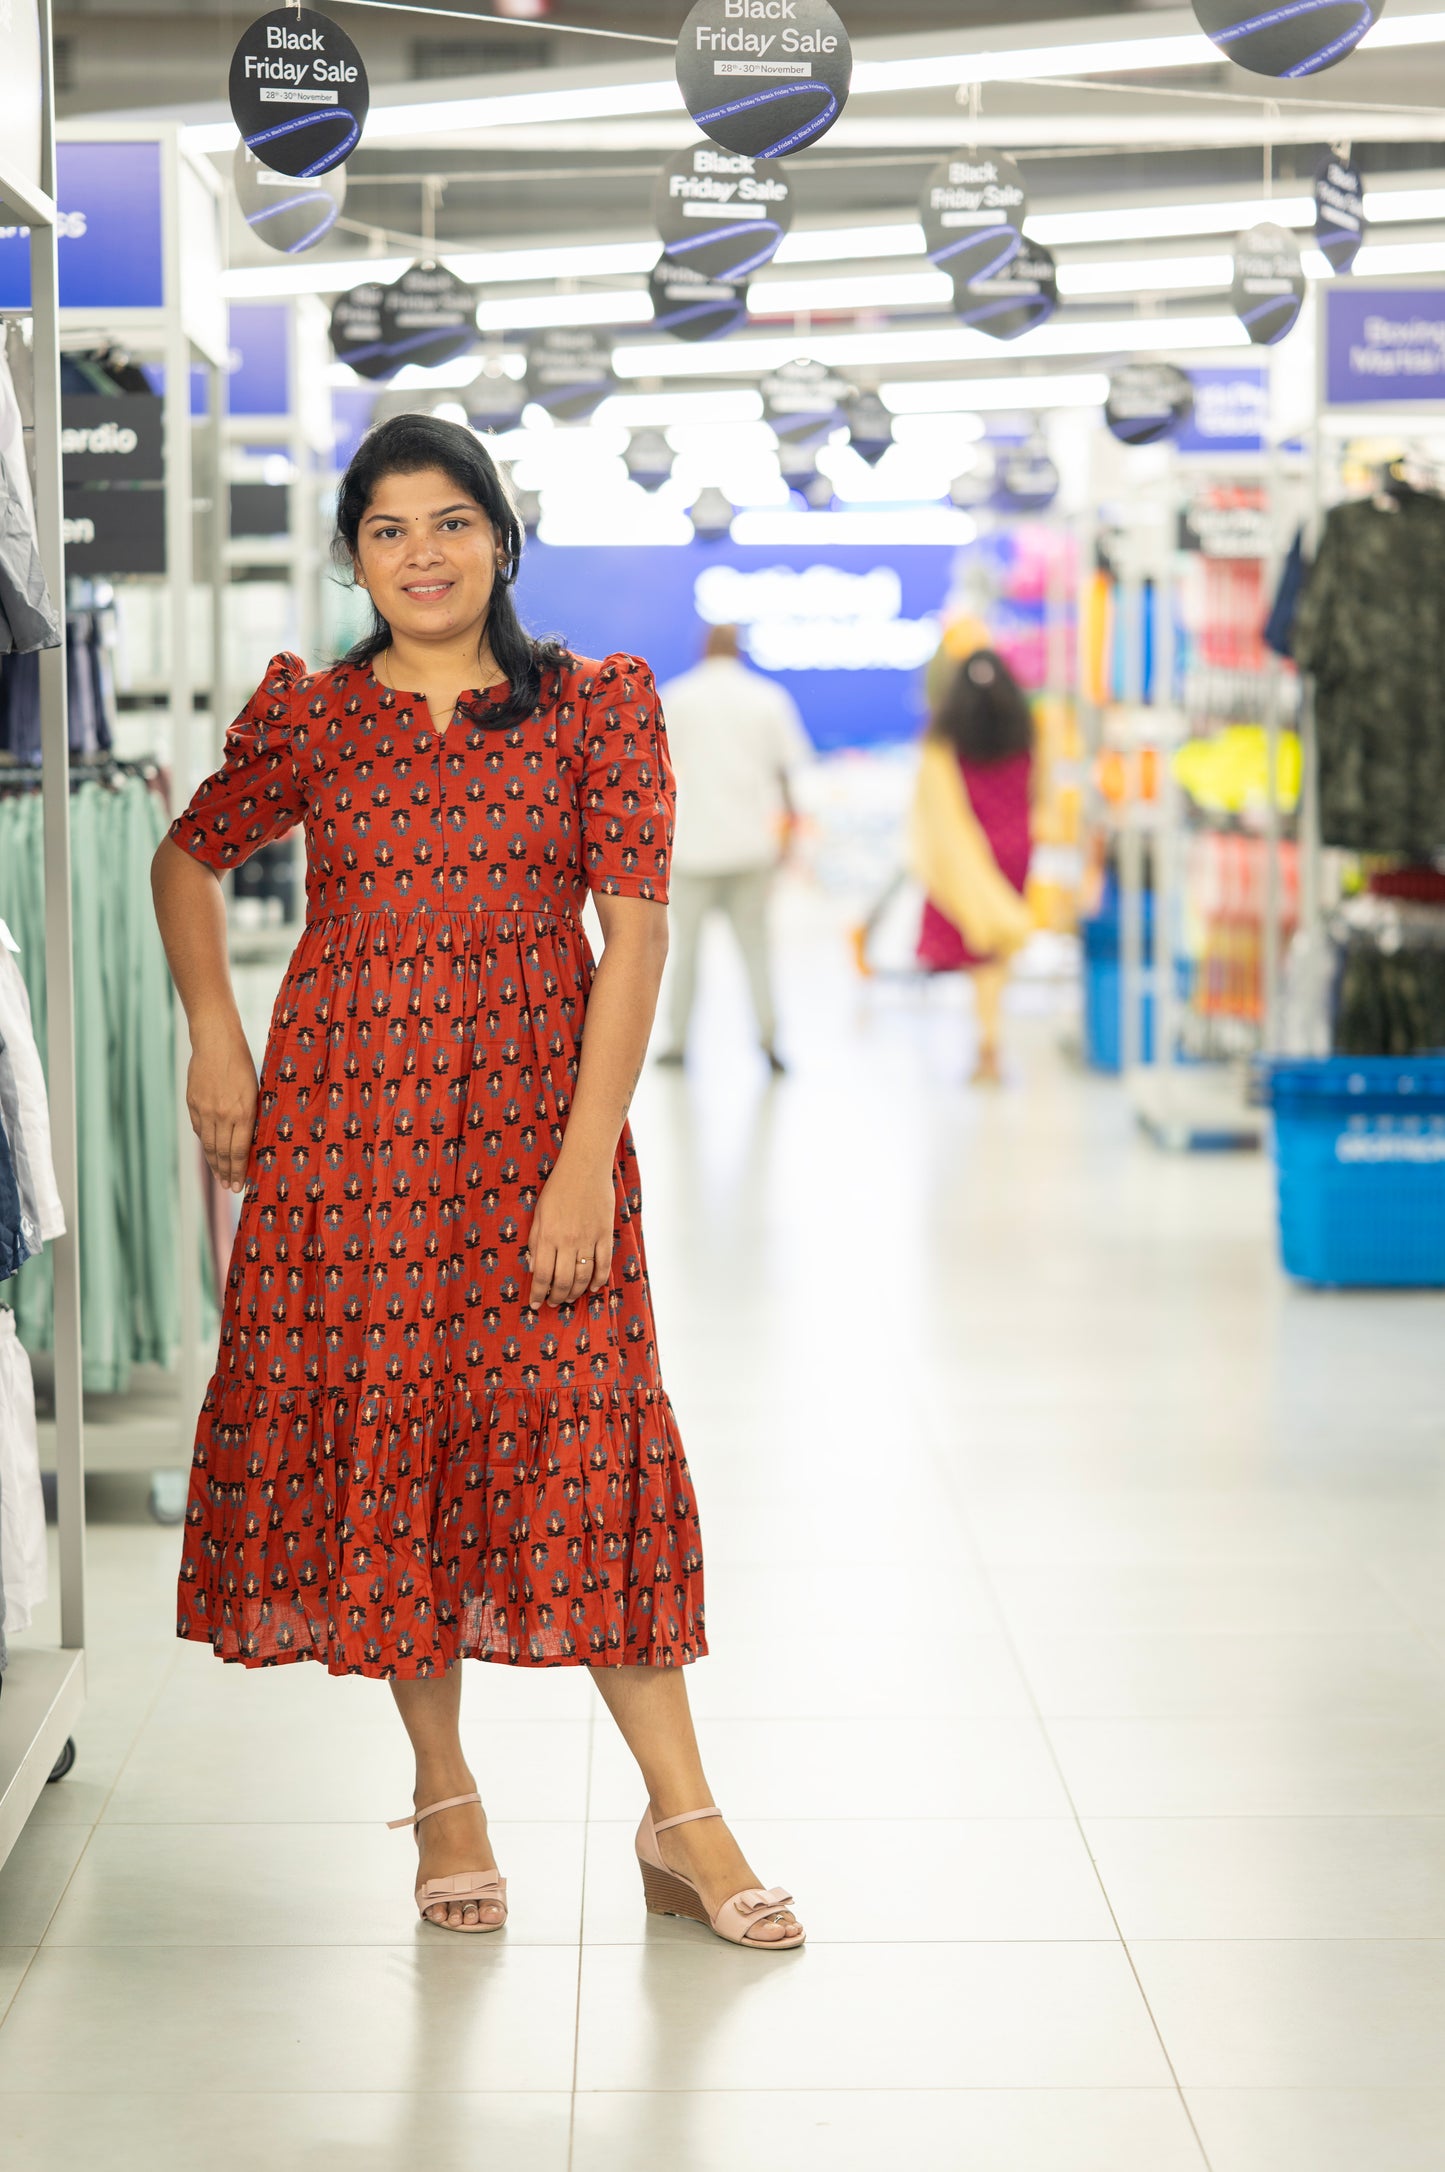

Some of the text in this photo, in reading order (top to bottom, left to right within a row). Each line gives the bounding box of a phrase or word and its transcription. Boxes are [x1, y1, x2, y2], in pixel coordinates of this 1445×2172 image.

[725, 0, 797, 19] Black
[266, 26, 325, 51] Black
[695, 26, 838, 57] Friday Sale
[244, 55, 358, 86] Friday Sale
[761, 65, 805, 74] November
[693, 150, 756, 174] Black
[949, 161, 998, 184] Black
[669, 175, 788, 203] Friday Sale
[930, 184, 1024, 211] Friday Sale
[62, 422, 138, 453] ardio
